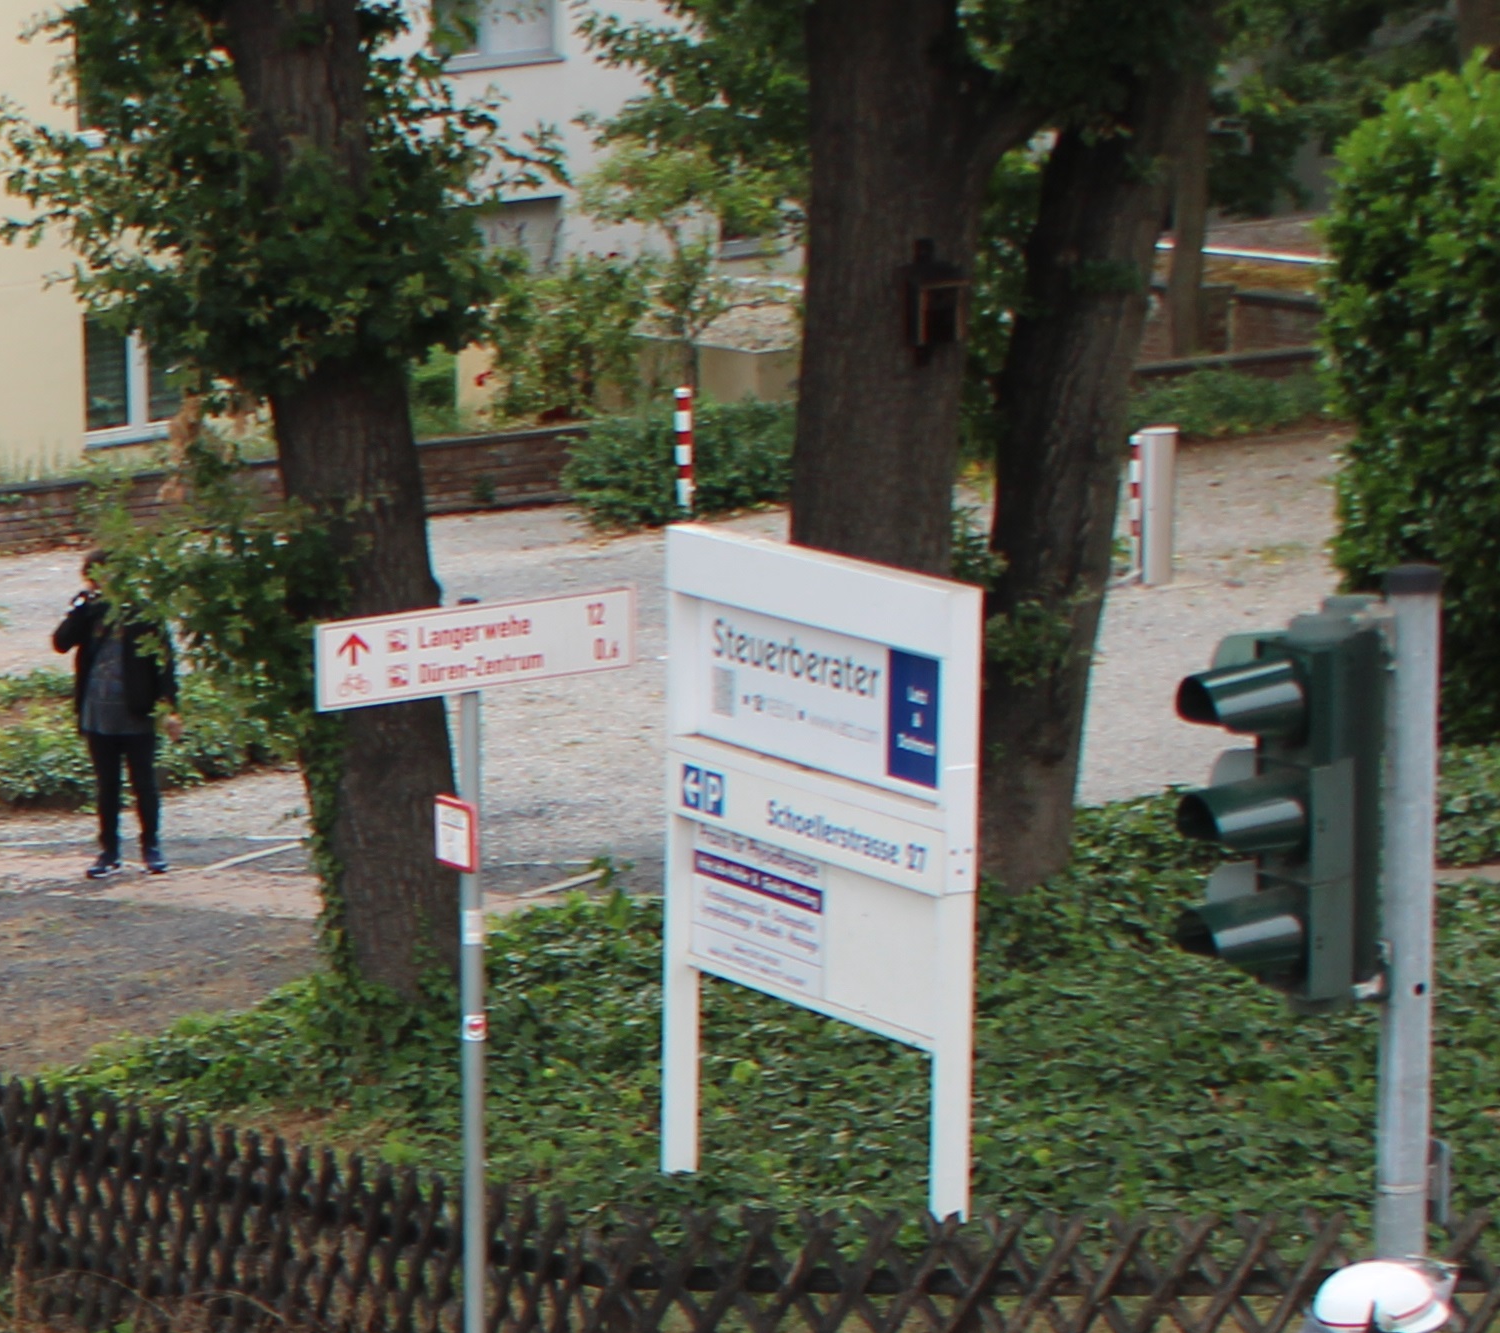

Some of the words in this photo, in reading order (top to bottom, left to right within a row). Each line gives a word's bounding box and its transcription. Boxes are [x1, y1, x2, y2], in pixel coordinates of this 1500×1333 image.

[416, 615, 532, 649] Langerwehe
[586, 602, 605, 626] 12
[417, 653, 544, 684] Düren-Zentrum
[712, 617, 881, 698] Steuerberater
[766, 799, 900, 865] Schoellerstrasse
